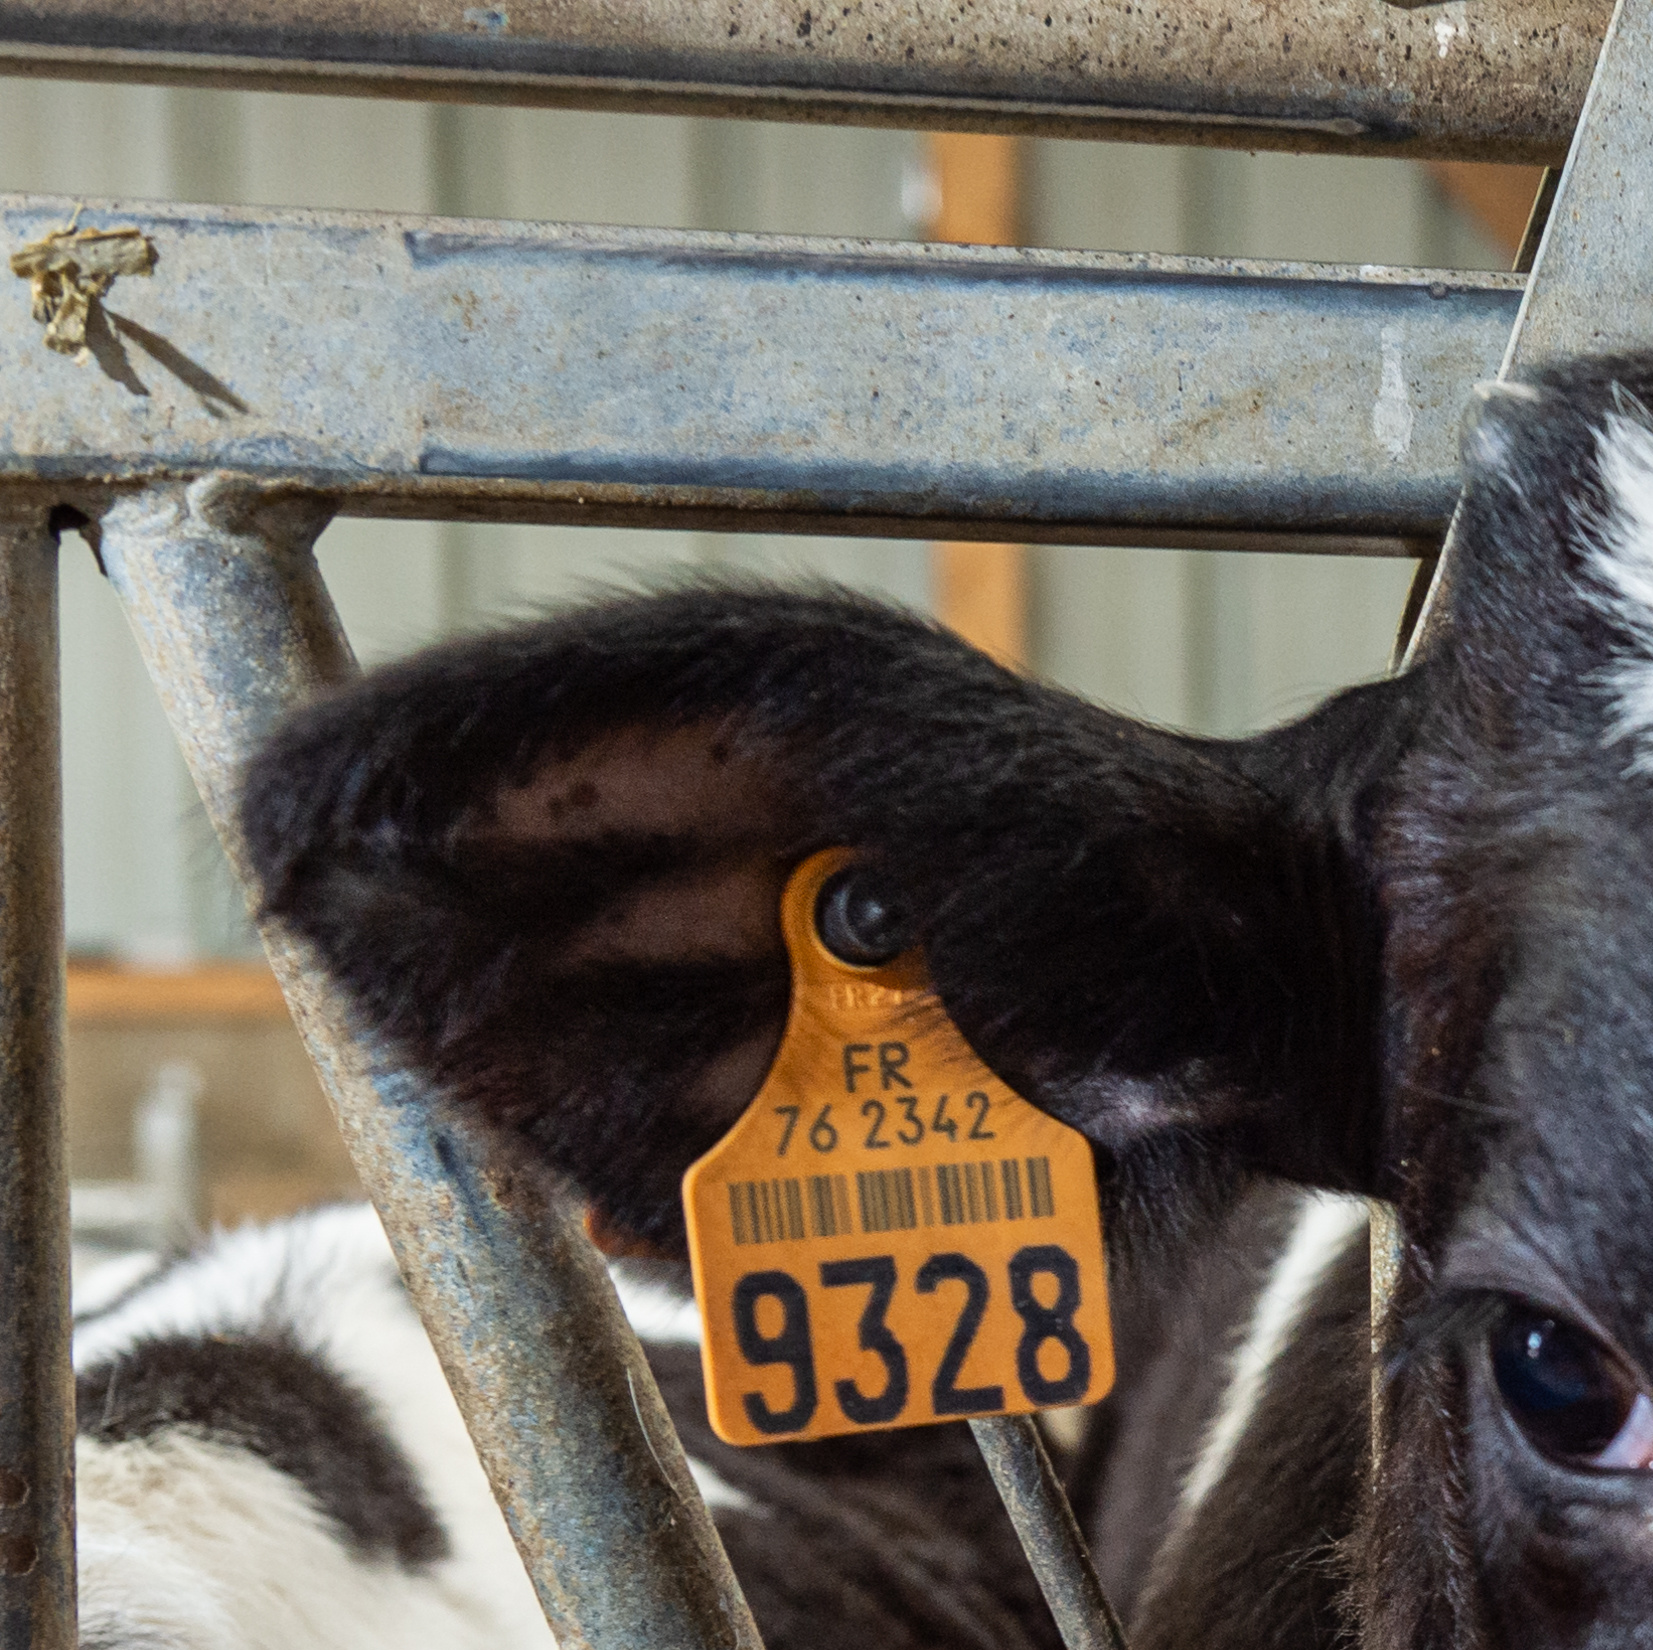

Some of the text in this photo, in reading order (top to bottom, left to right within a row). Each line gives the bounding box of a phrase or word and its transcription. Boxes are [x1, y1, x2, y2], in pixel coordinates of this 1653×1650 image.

[843, 1041, 914, 1094] FR
[774, 1090, 996, 1157] 76 2342
[731, 1244, 1093, 1435] 9328
